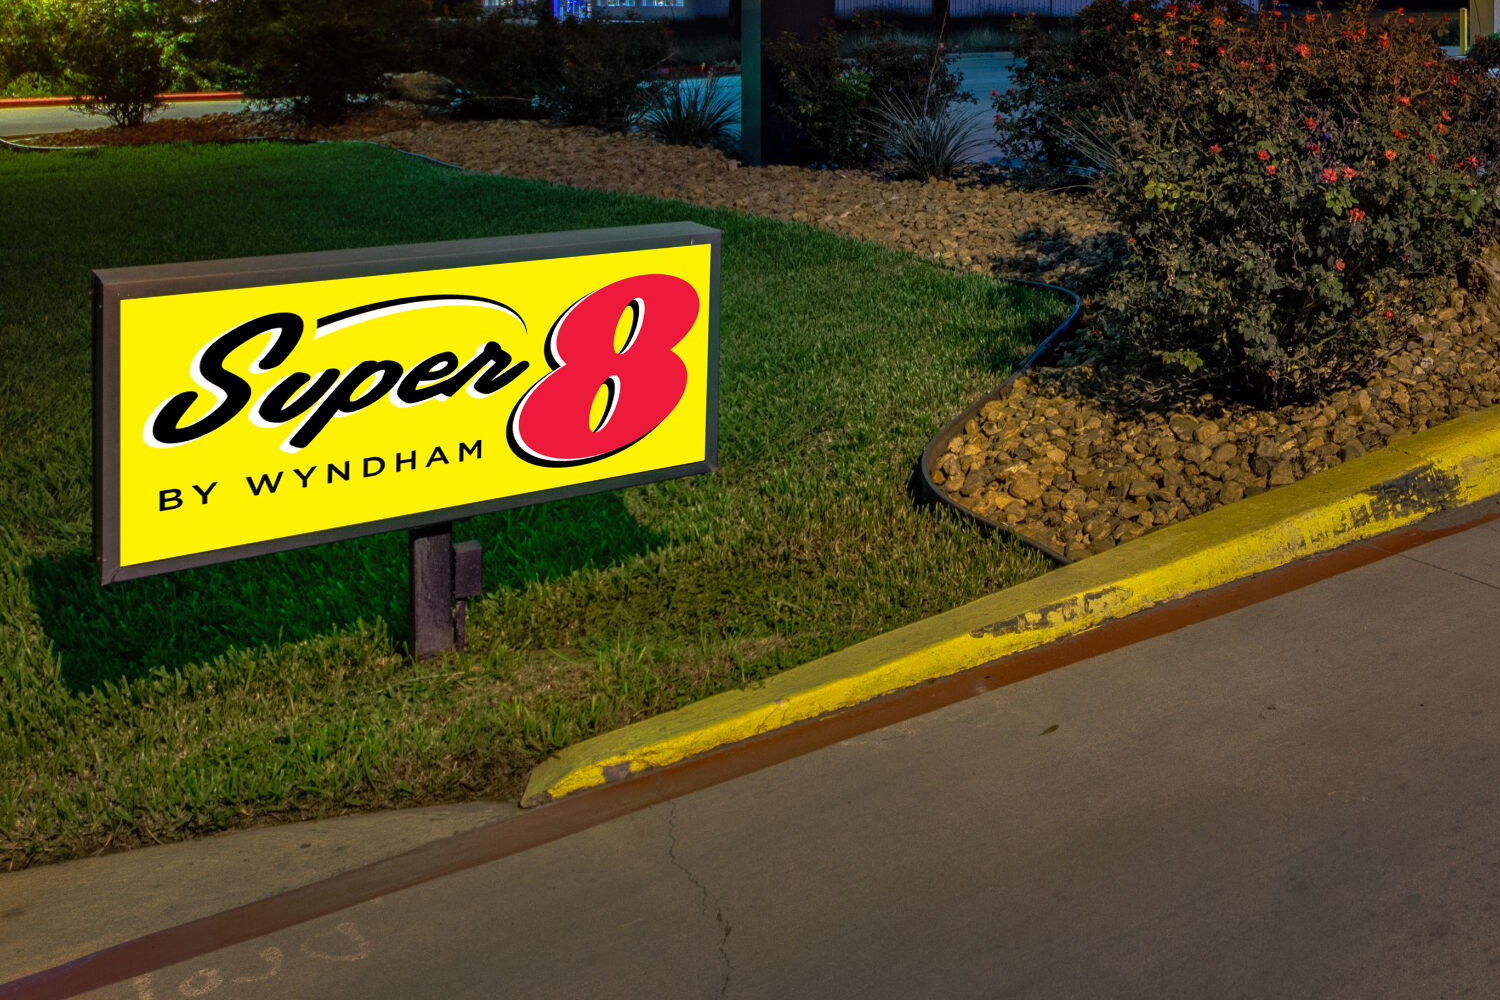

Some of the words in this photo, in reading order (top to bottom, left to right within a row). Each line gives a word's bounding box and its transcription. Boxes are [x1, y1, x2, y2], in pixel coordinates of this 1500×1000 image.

[144, 312, 530, 453] Super
[506, 274, 700, 469] 8
[158, 481, 219, 512] BY
[246, 439, 483, 498] WYNDHAM
